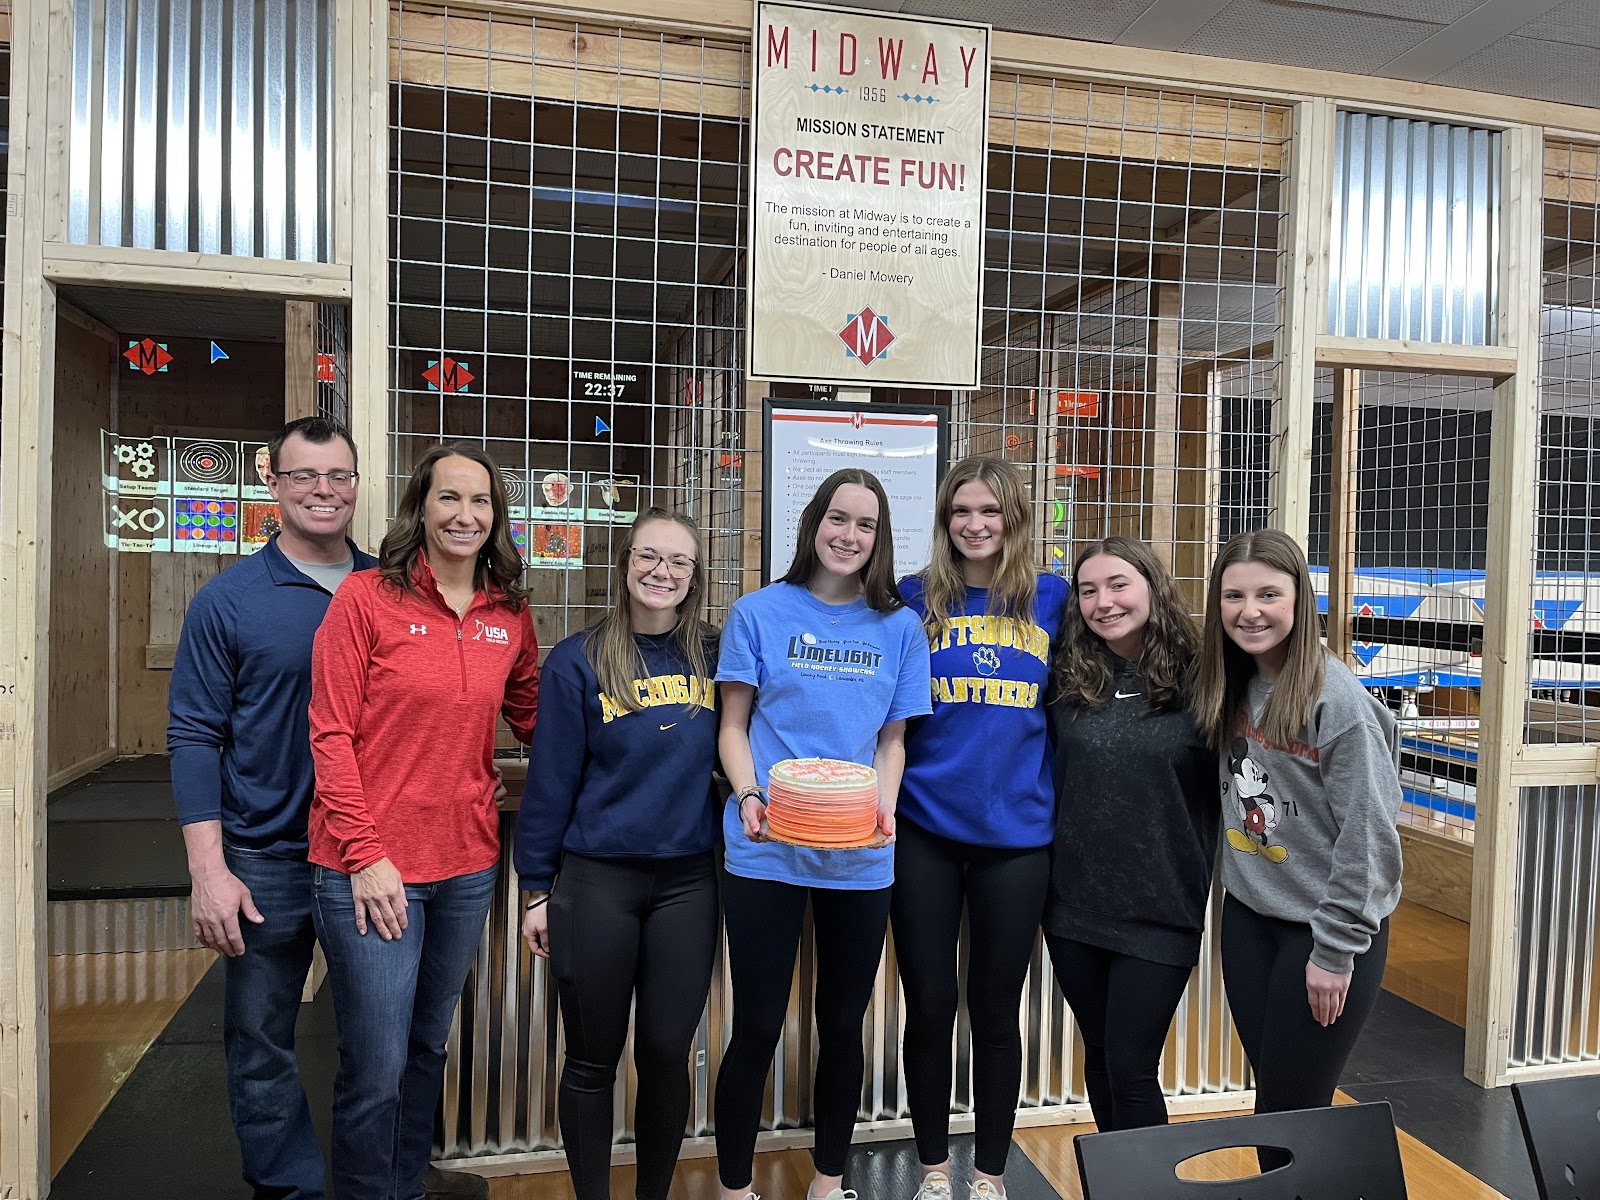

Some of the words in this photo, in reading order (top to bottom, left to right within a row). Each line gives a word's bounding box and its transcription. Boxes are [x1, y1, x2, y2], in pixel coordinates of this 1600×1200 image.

[767, 24, 977, 88] MIDWAY
[859, 86, 886, 103] 1956
[796, 117, 857, 137] MISSION
[861, 123, 945, 145] STATEMENT
[773, 147, 890, 186] CREATE
[900, 159, 966, 192] FUN!
[765, 201, 788, 215] The
[791, 205, 835, 218] mission
[839, 208, 850, 219] at
[853, 208, 897, 225] Midway
[900, 212, 909, 224] is
[912, 214, 923, 225] to
[926, 217, 961, 228] create
[963, 219, 971, 229] a
[789, 218, 810, 233] fun,
[814, 221, 854, 236] inviting
[858, 225, 879, 237] and
[882, 228, 948, 243] entertaining
[774, 233, 837, 249] destination
[840, 239, 856, 250] for
[859, 241, 897, 254] people
[901, 244, 912, 254] of
[914, 245, 927, 255] all
[930, 248, 961, 259] ages.
[830, 267, 866, 281] Daniel
[869, 270, 914, 285] Mowery
[856, 315, 877, 358] M
[573, 371, 593, 379] TIME
[585, 382, 625, 397] 22:37
[834, 438, 864, 447] Throwing
[801, 450, 831, 458] participants
[485, 626, 508, 640] USA
[811, 663, 837, 672] HOCKEY
[839, 666, 876, 676] SHOWCASE
[1419, 675, 1426, 685] 2
[1431, 675, 1439, 686] 3
[930, 677, 1039, 709] PANTHERS
[1282, 801, 1299, 817] 71
